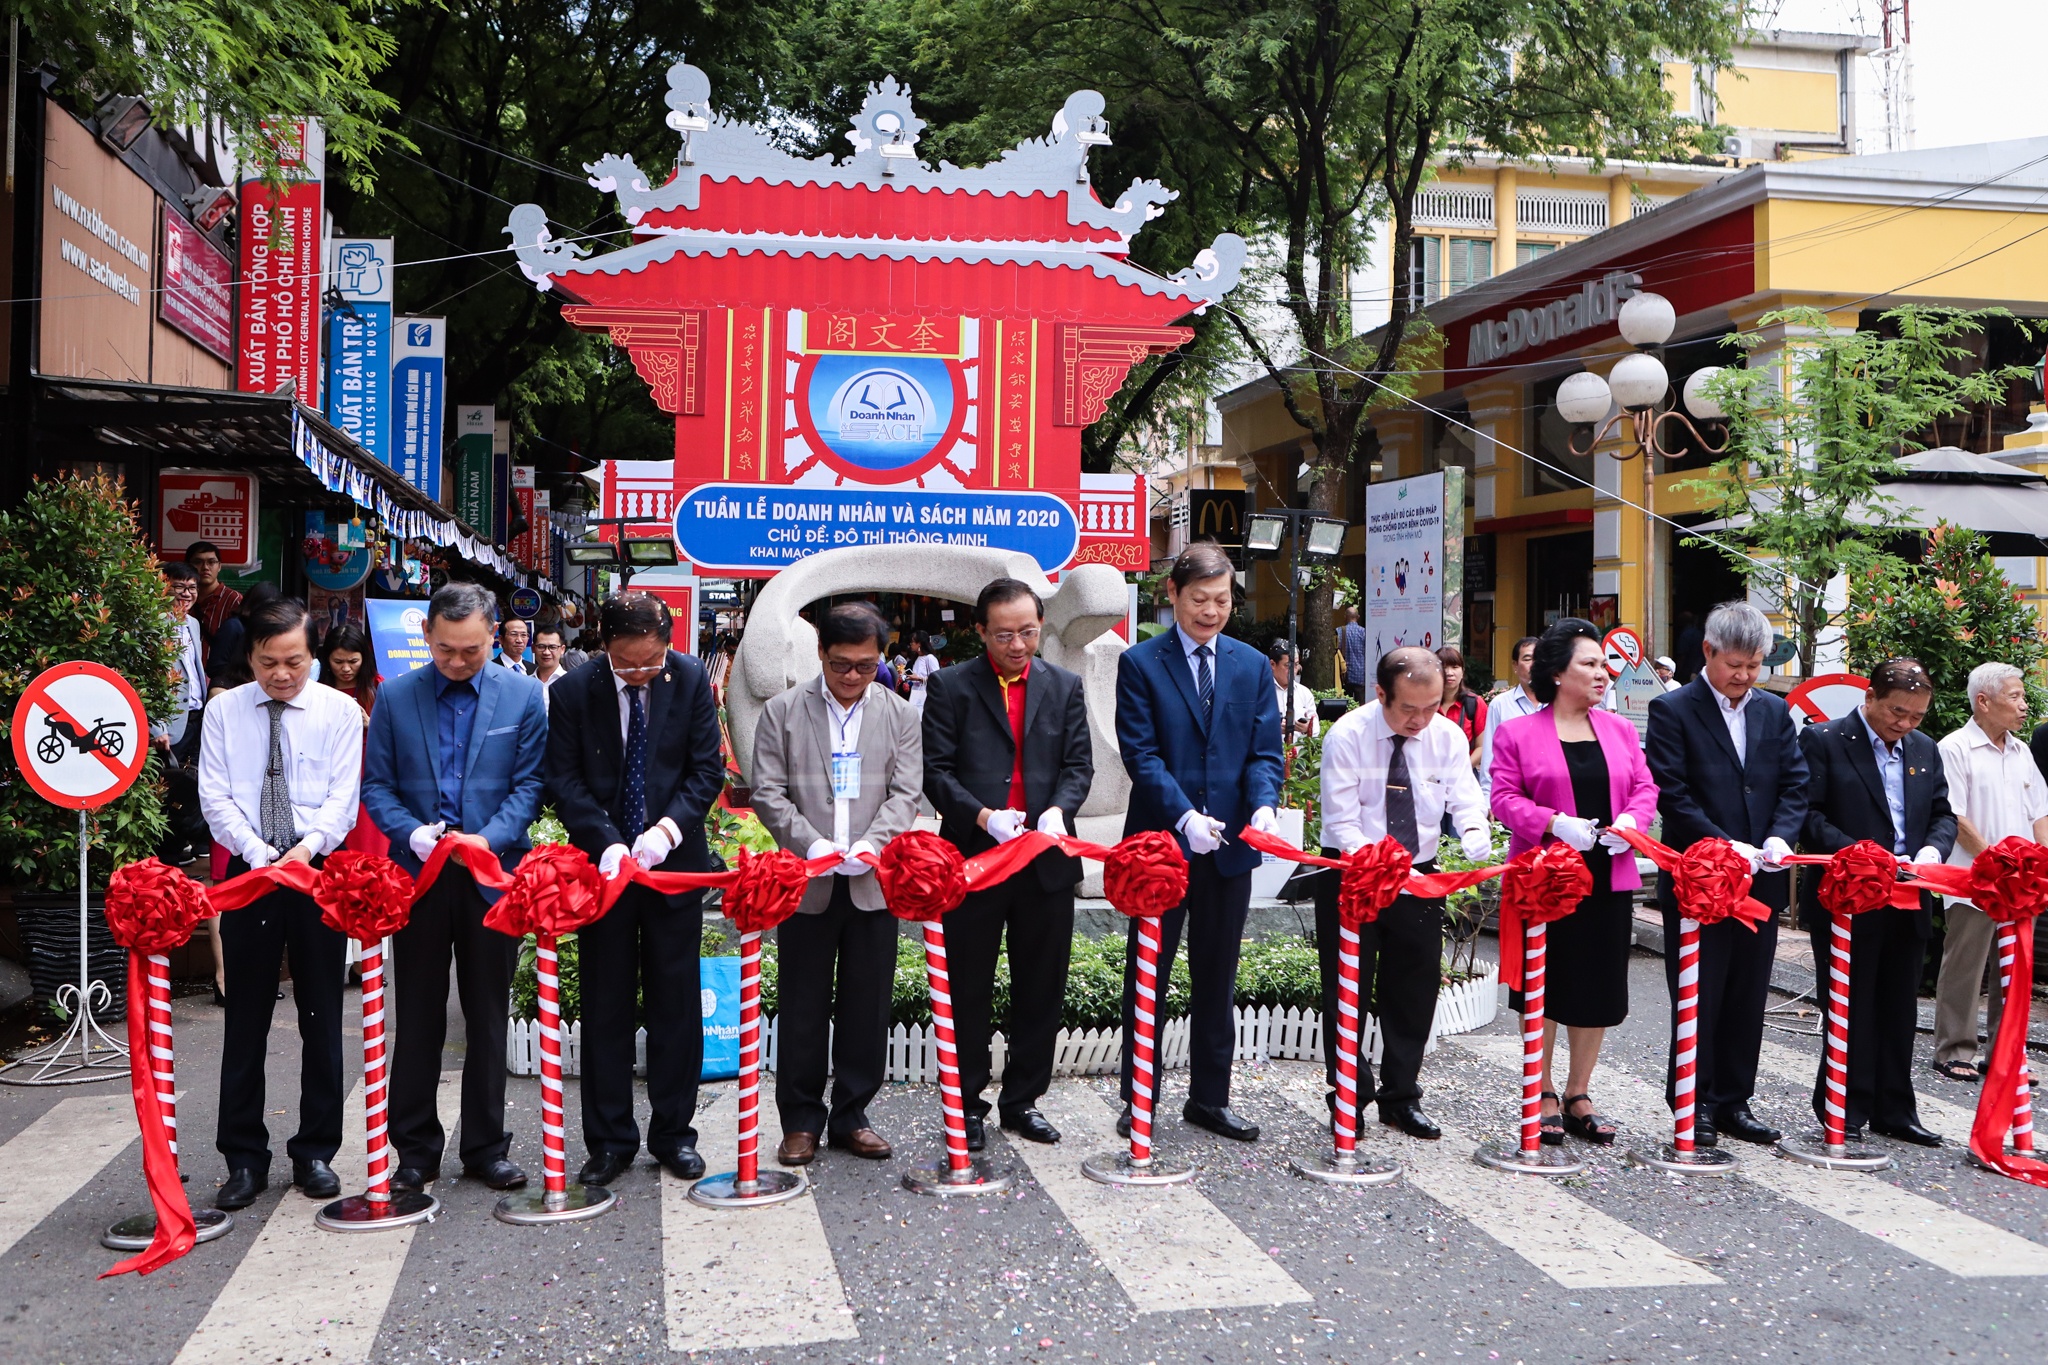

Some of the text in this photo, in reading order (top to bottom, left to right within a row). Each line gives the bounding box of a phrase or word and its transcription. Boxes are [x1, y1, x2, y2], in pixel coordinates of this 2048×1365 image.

[52, 184, 148, 272] www.nxbhcm.com.vn
[251, 203, 272, 239] HỢP
[61, 238, 139, 305] www.sachweb.vn
[243, 245, 269, 293] TỔNG
[274, 255, 294, 287] CHÍ
[245, 298, 267, 334] BẢN
[271, 292, 293, 317] HỒ
[299, 207, 312, 407] HI MINH CITY GENERAL PUBLISHING HOUSE
[1467, 270, 1643, 367] McDonald's
[270, 321, 292, 359] PHỐ
[243, 339, 266, 385] XUẤT
[335, 352, 362, 390] BẢN
[366, 313, 377, 455] PUBLISHING HOUSE
[335, 394, 362, 442] XUẤT
[850, 410, 916, 421] Doanh Nhân
[467, 471, 480, 526] NHÃ NAM
[694, 495, 1060, 528] TUẦN LỄ DOANH NHÂN VÀ SÁCH NĂM 2020
[1406, 507, 1415, 518] CÁC
[1425, 504, 1437, 514] PHÁP
[768, 524, 801, 542] CHỦ
[805, 524, 829, 543] ĐỀ:
[834, 528, 858, 544] ĐÔ
[889, 529, 943, 544] THÔNG
[948, 533, 987, 546] MINH
[1383, 520, 1397, 532] CHỐNG
[1397, 522, 1407, 532] DỊCH
[1408, 519, 1419, 530] BỆNH
[1420, 517, 1439, 526] COVID-19
[750, 547, 778, 558] KHAI
[514, 598, 537, 606] BOOK
[387, 650, 411, 659] DOANH
[1624, 695, 1630, 710] 1
[703, 1025, 739, 1036] hNhân
